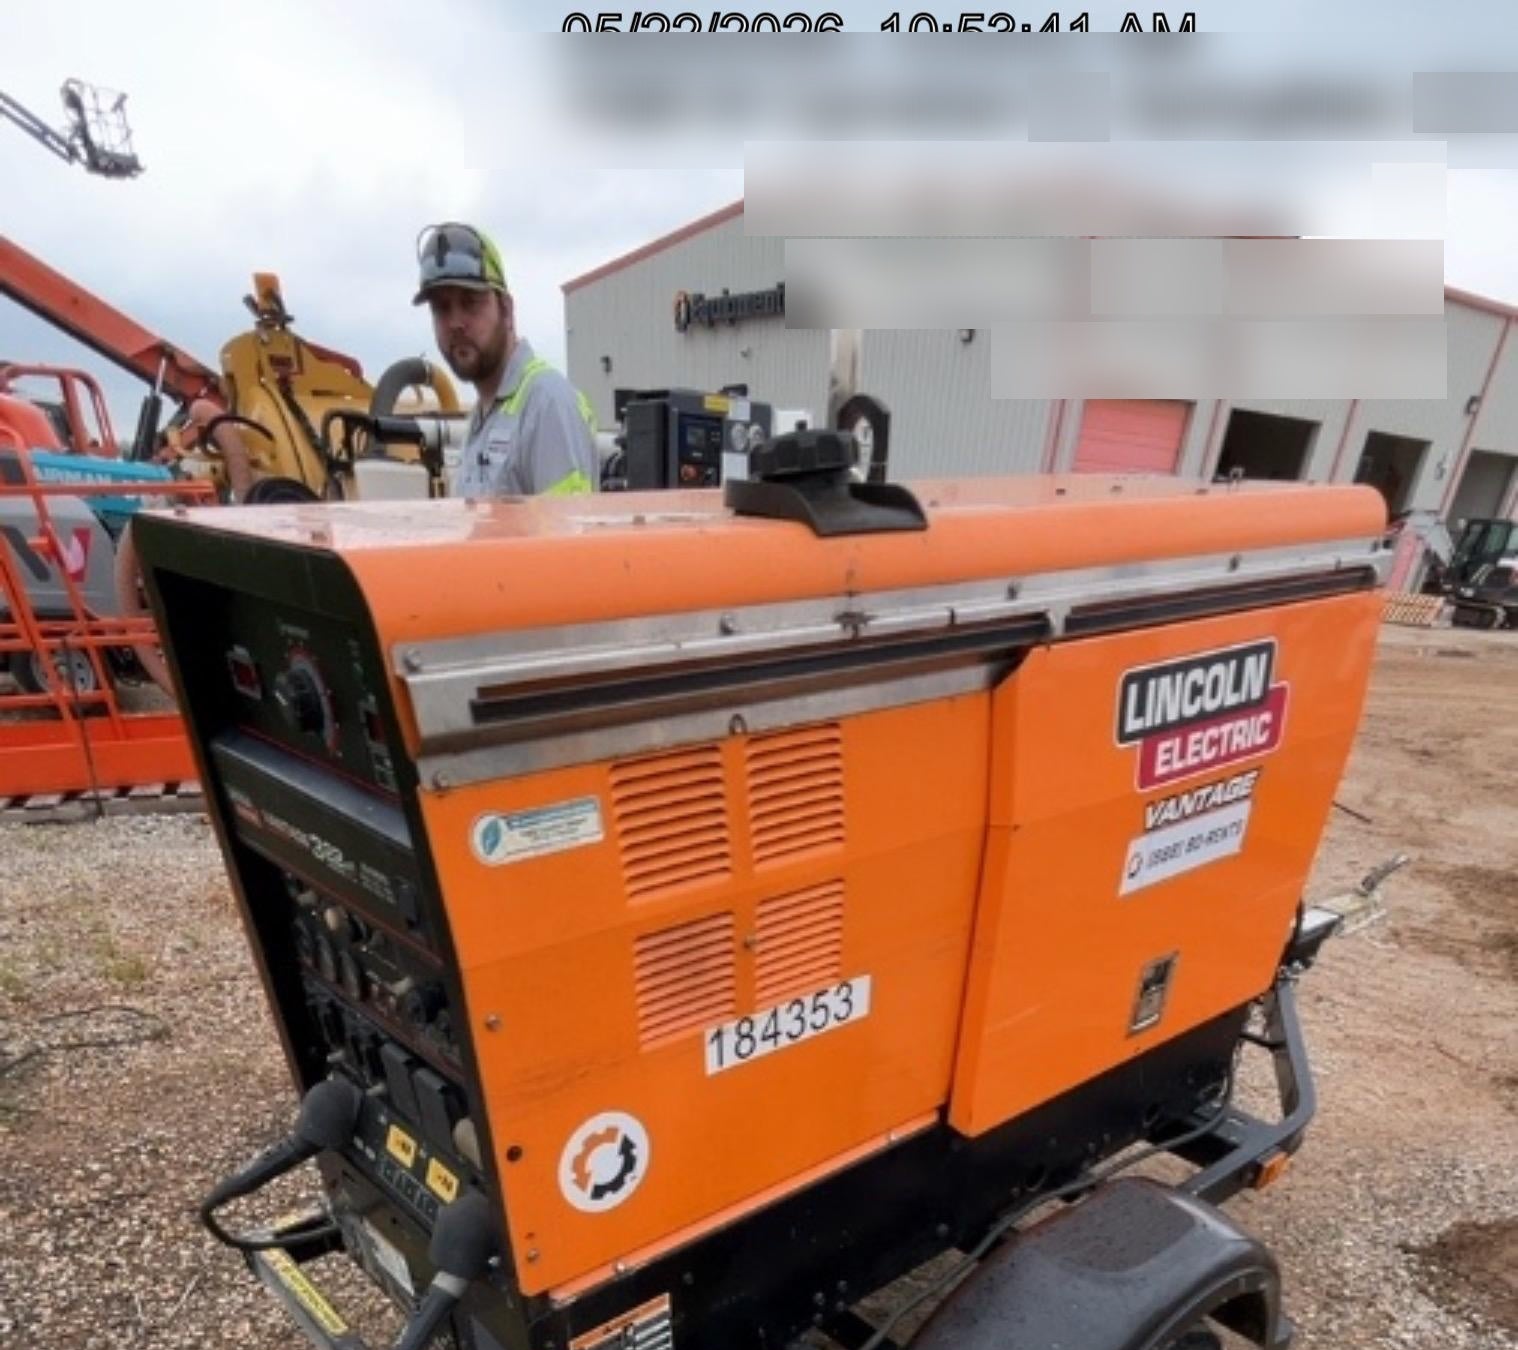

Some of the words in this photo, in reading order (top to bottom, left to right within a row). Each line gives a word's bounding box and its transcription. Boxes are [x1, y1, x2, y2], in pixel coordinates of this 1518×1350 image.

[1124, 651, 1269, 735] LINCOLN
[1154, 710, 1273, 778] ELECTRIC
[1145, 769, 1260, 831] VANTAGE
[709, 981, 854, 1068] 184353
